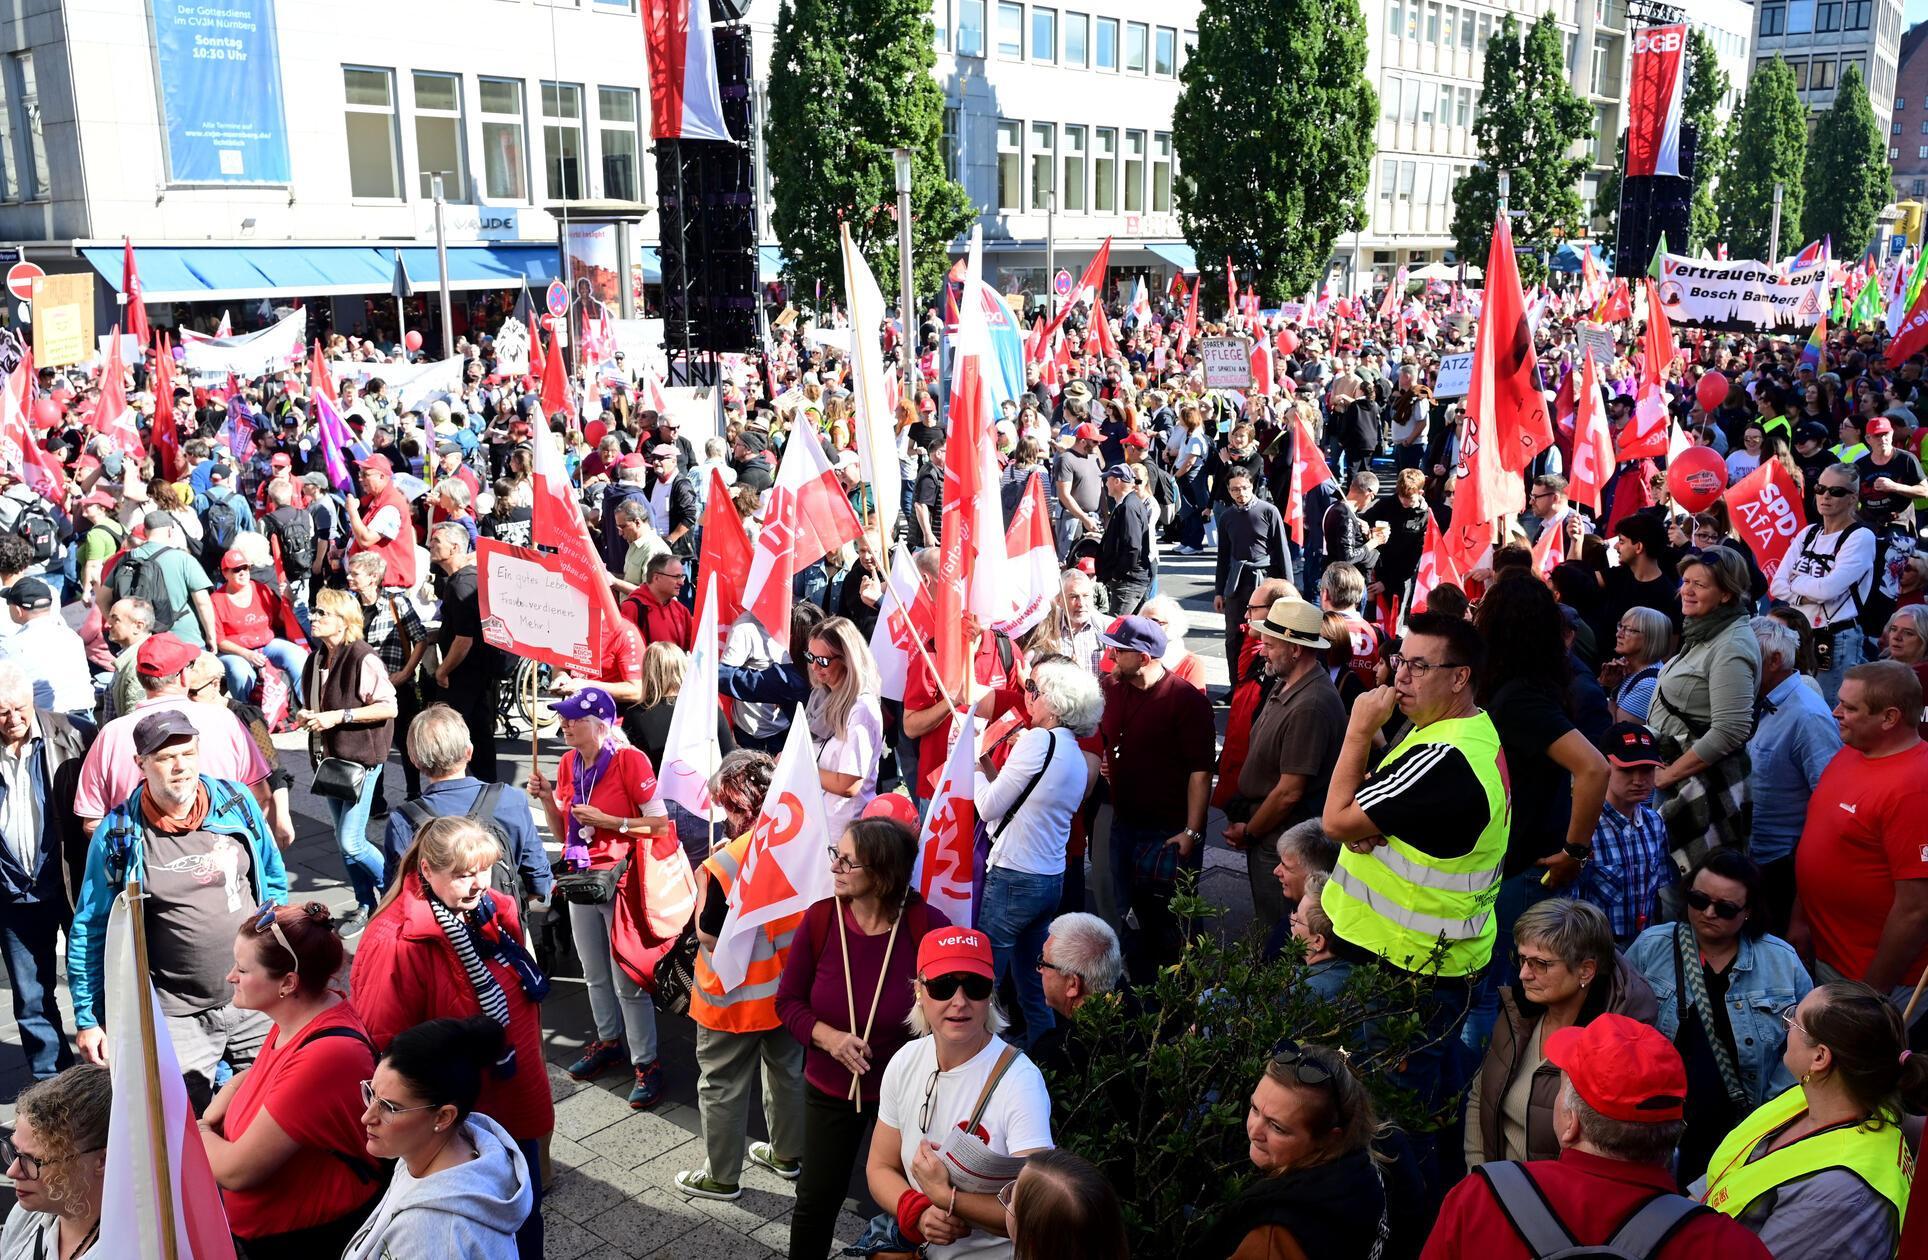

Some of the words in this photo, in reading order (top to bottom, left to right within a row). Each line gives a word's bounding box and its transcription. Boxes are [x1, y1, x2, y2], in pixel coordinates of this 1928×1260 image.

[177, 5, 195, 15] Der
[196, 6, 252, 20] Gottesdienst
[216, 18, 257, 32] Nürnberg
[194, 34, 243, 50] Sonntag
[1635, 33, 1681, 54] DGB
[192, 47, 225, 60] 10:30
[227, 49, 248, 61] Uhr
[453, 217, 514, 230] VAUDE
[1690, 286, 1738, 301] Bosch
[1742, 291, 1800, 307] Bamberg
[1204, 348, 1243, 361] PFLEGE
[1440, 357, 1470, 371] ATZ
[1759, 482, 1798, 537] SPD
[1735, 500, 1775, 550] AfA
[497, 565, 513, 580] Ein
[515, 571, 538, 589] gutes
[937, 935, 979, 948] ver.di
